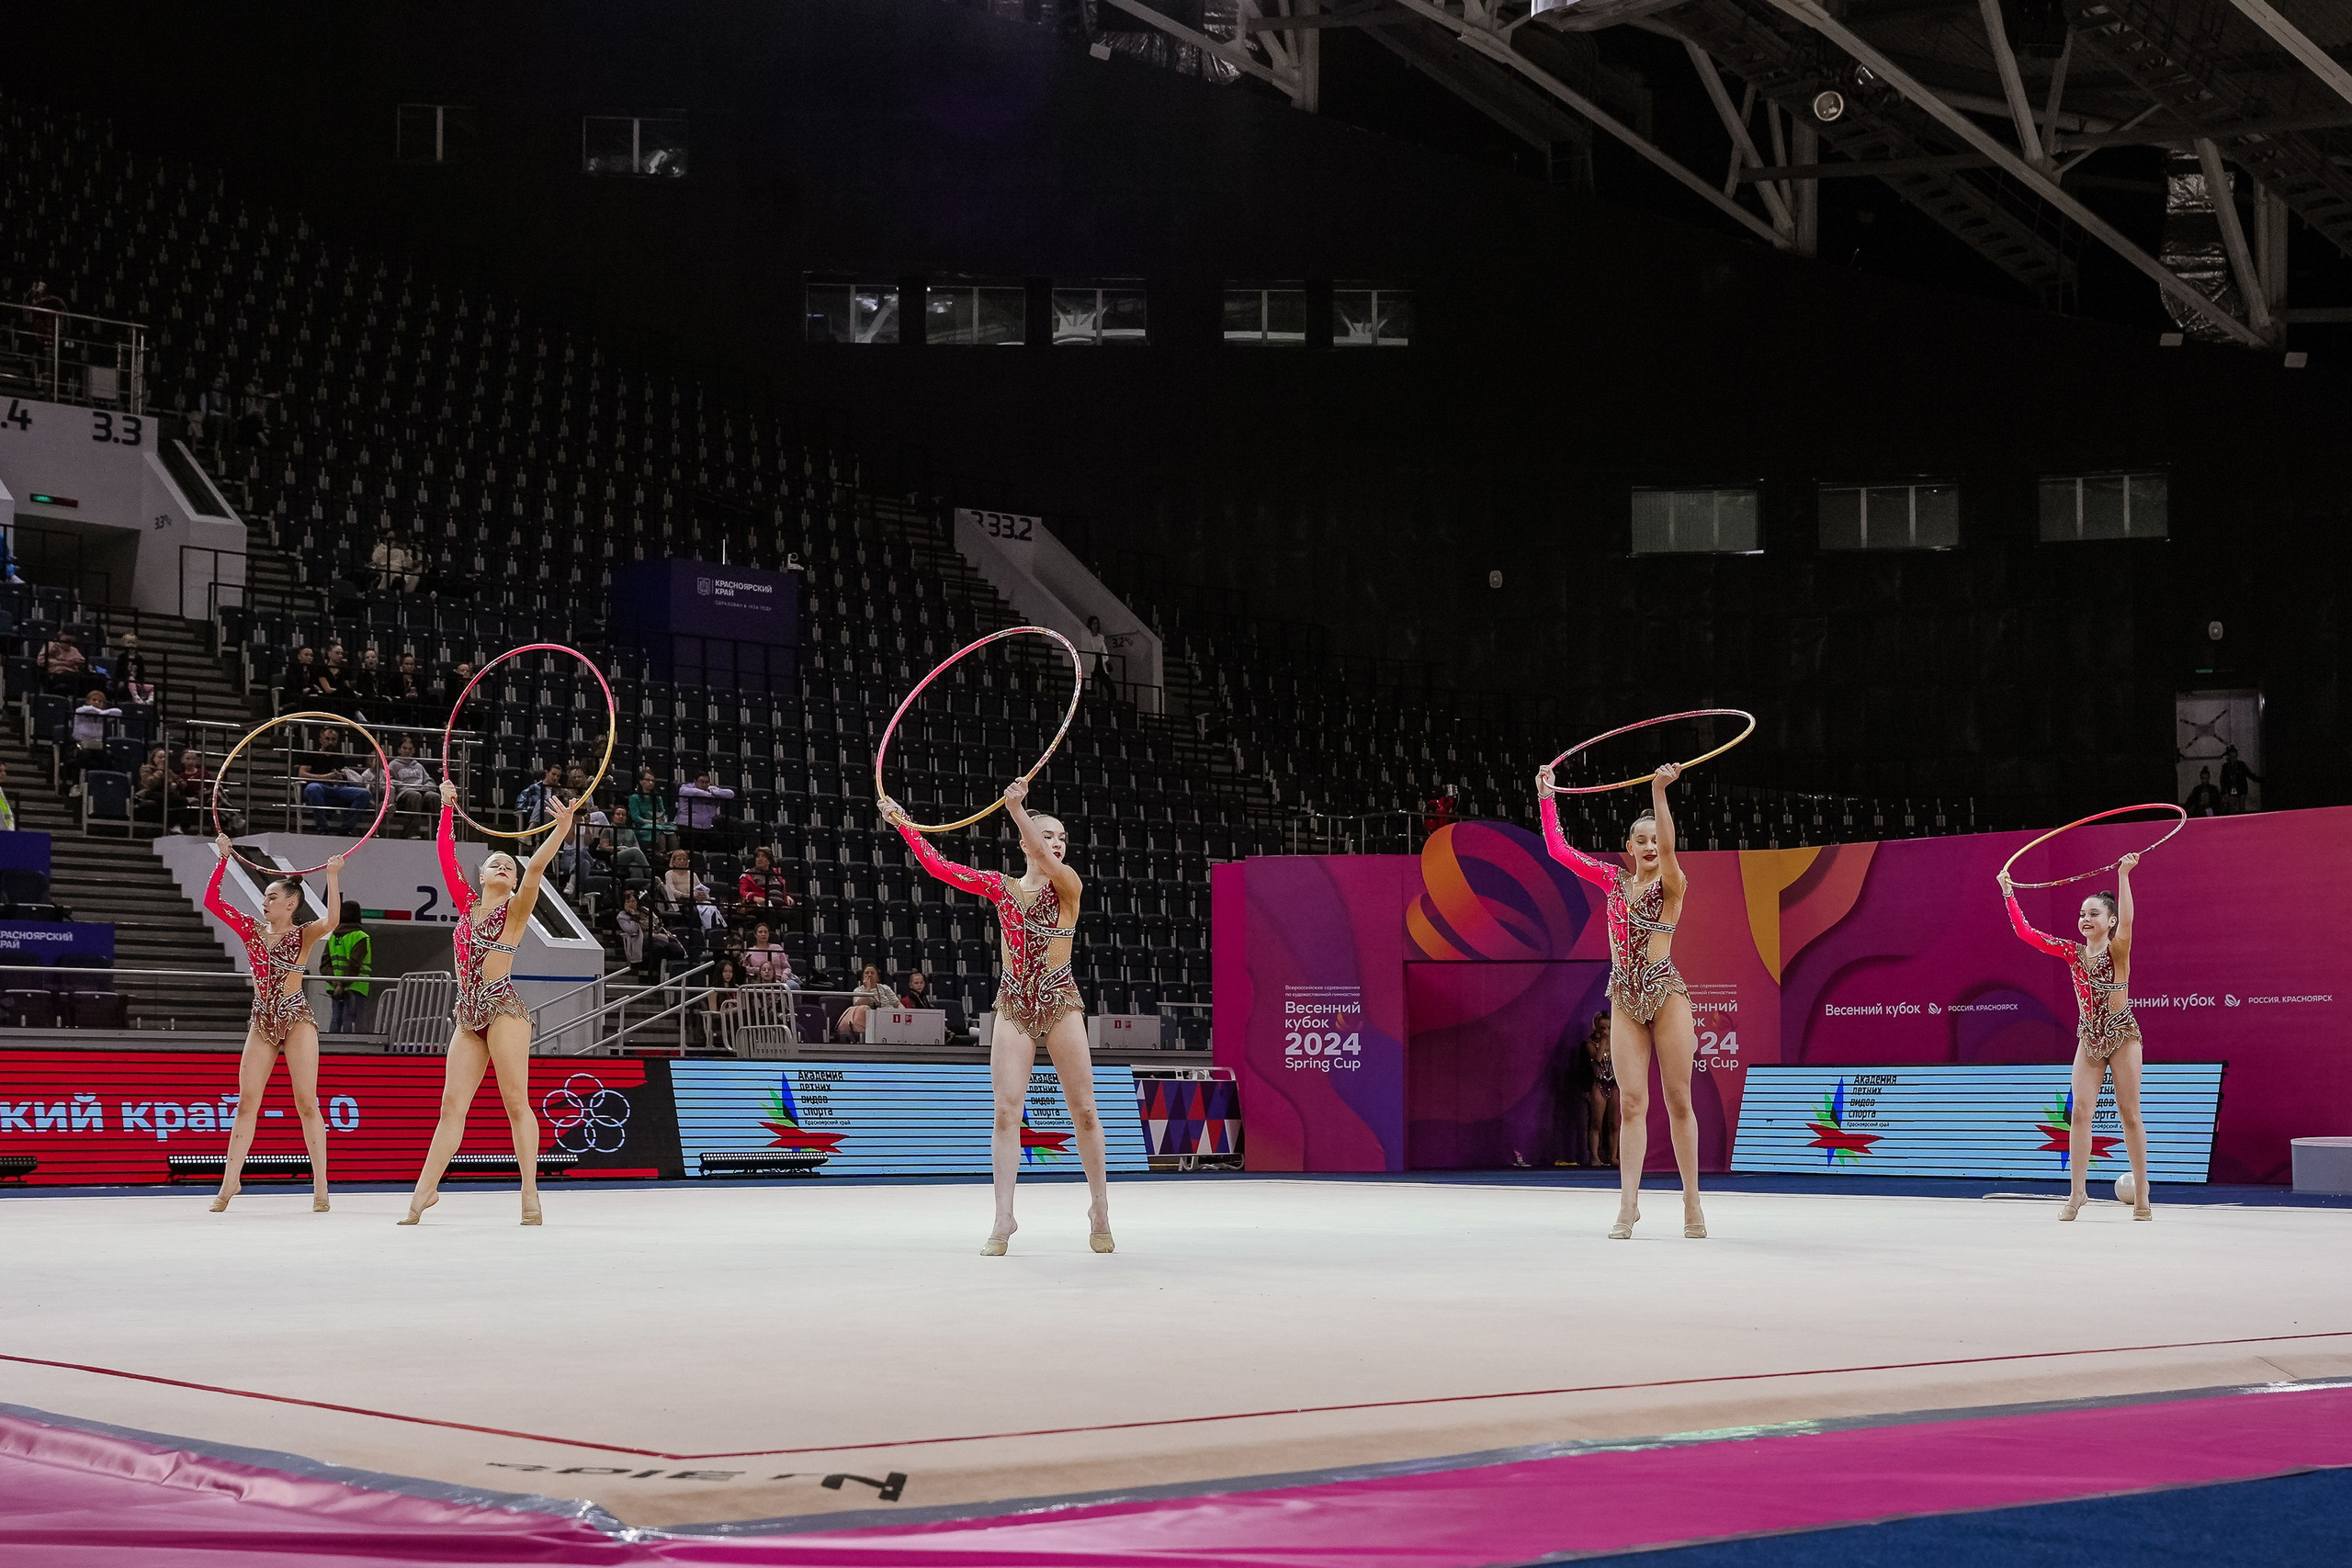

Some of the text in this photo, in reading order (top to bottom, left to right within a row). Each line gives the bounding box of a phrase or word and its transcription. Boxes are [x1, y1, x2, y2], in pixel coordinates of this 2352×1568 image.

[92, 411, 142, 446] 3.3
[715, 579, 773, 593] КРАСНОЯРСКИЙ
[715, 588, 734, 597] КРАЙ
[0, 930, 73, 942] РАСНОЯРСКИЙ
[0, 940, 20, 950] РАЙ
[2127, 992, 2216, 1010] енний кубок
[2248, 995, 2333, 1005] РОССИЯ, КРАСНОЯРСК
[1284, 1000, 1361, 1014] Весенний
[1690, 999, 1738, 1012] енний
[1825, 1001, 1921, 1018] Весенний кубок
[1948, 1003, 2018, 1013] РОССИЯ, КРАСНОЯРСК
[1284, 1015, 1329, 1032] кубок
[1284, 1032, 1362, 1056] 2024
[1693, 1031, 1739, 1055] 24
[1284, 1056, 1362, 1073] Spring Cup
[1710, 1056, 1739, 1071] Cup
[797, 1071, 844, 1081] Академия
[1028, 1073, 1060, 1083] Академ
[1853, 1075, 1897, 1085] Академия
[799, 1083, 832, 1092] летних
[1852, 1087, 1883, 1095] летних
[801, 1096, 829, 1105] видов
[1031, 1097, 1056, 1107] видов
[1849, 1098, 1876, 1108] видов
[2096, 1099, 2116, 1108] дов
[0, 1093, 104, 1133] кий
[121, 1093, 241, 1142] край
[803, 1108, 833, 1118] спорта
[1033, 1109, 1060, 1119] спорта
[1848, 1110, 1877, 1120] спорта
[2094, 1111, 2116, 1122] орта
